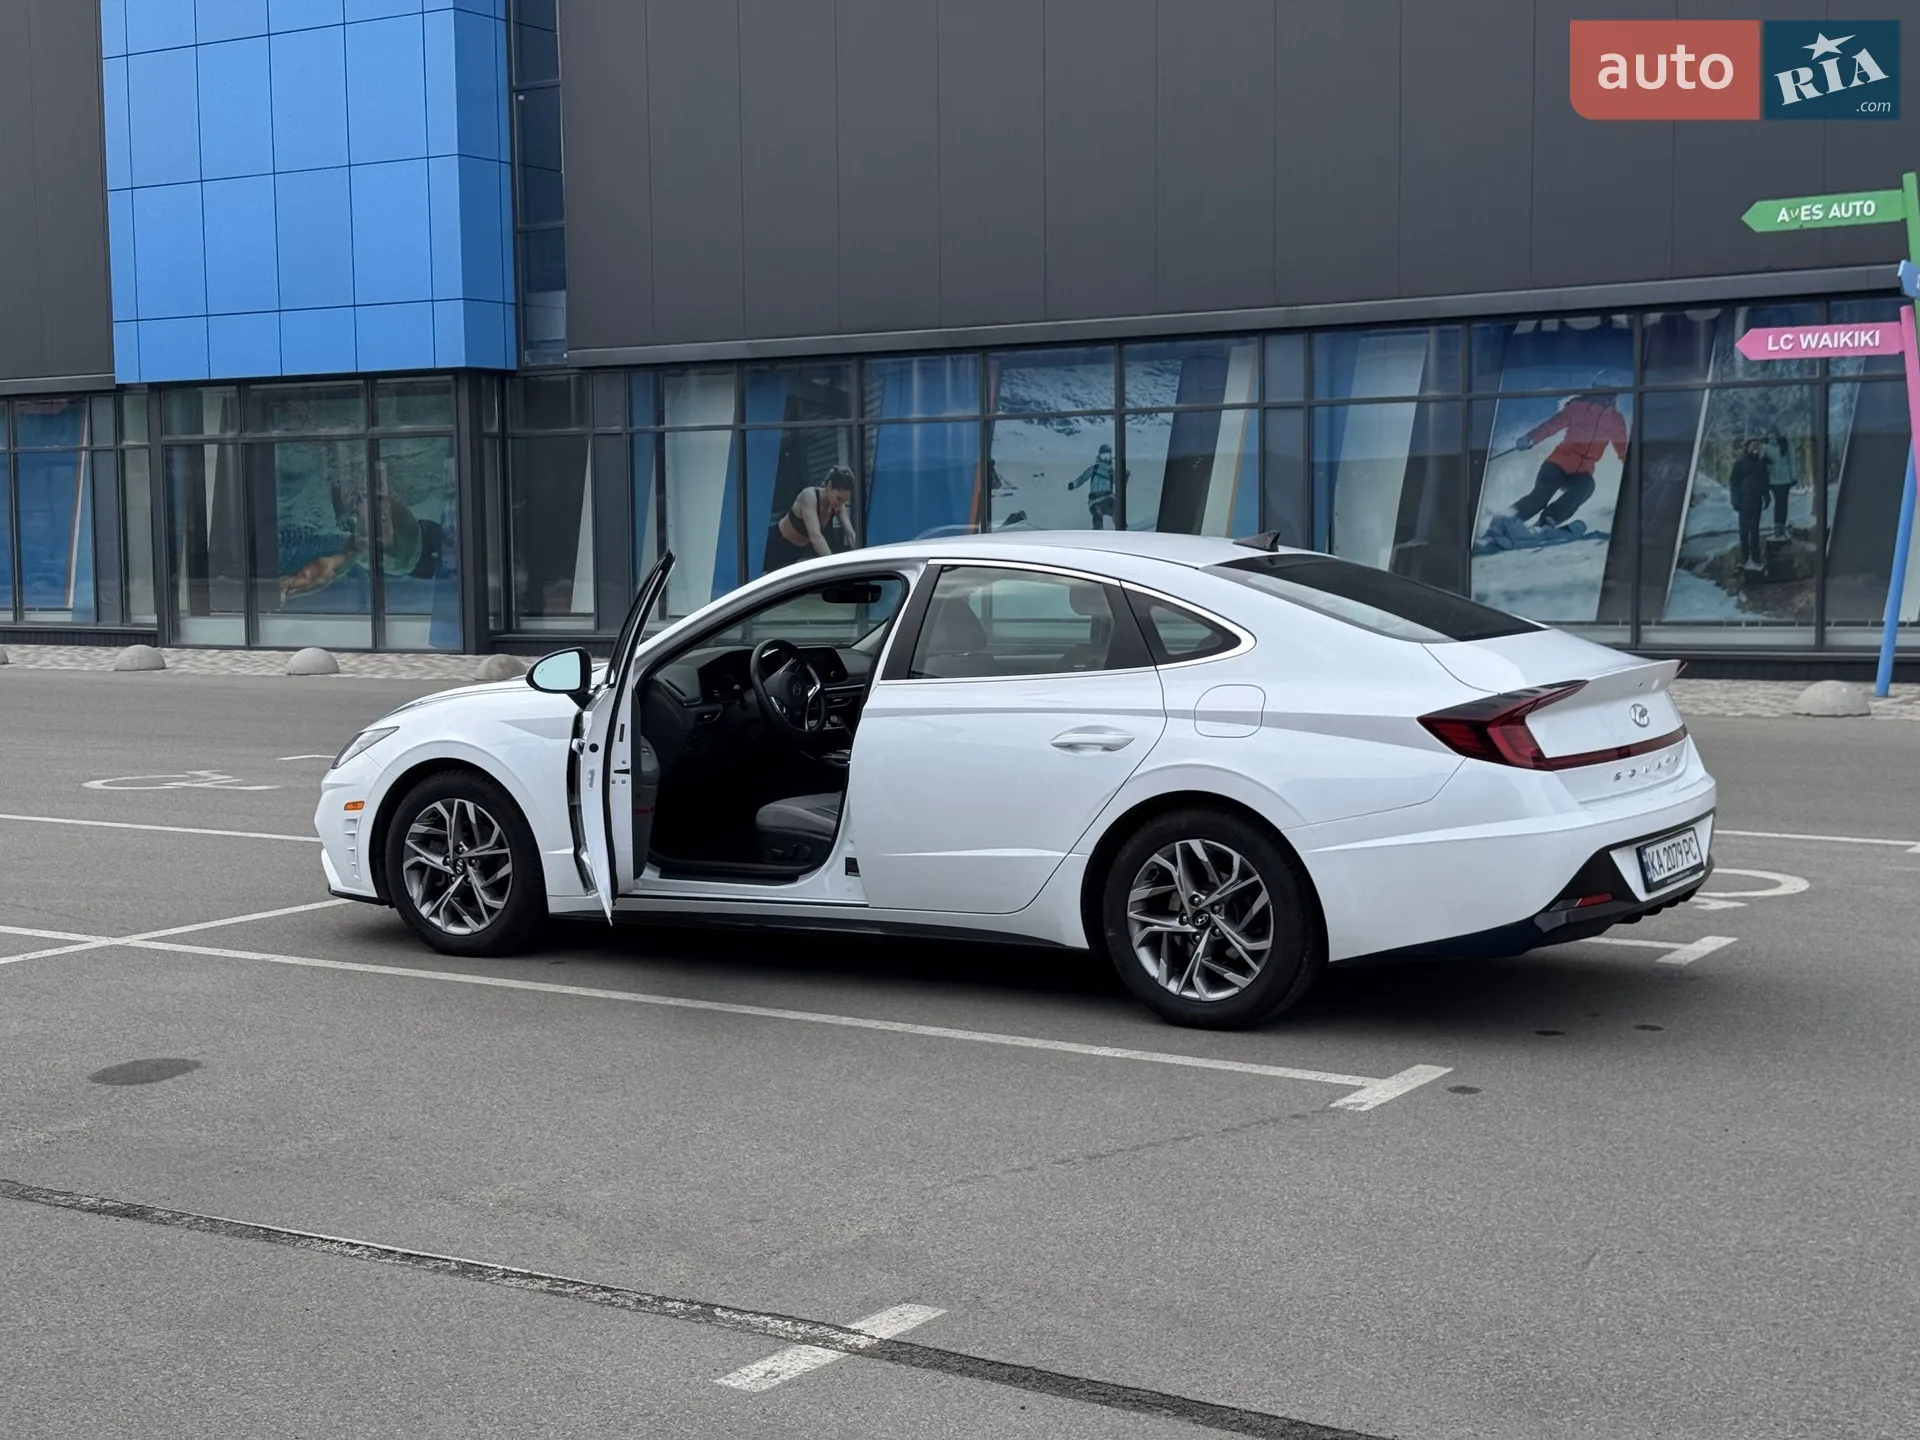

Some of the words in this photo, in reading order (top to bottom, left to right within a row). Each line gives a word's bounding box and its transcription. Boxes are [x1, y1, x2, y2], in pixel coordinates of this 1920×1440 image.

[1828, 200, 1876, 218] AUTO
[1767, 333, 1794, 351] LC
[1799, 329, 1881, 350] WAIKIKI
[1648, 849, 1665, 878] KA
[1663, 841, 1684, 872] 2079
[1682, 836, 1698, 864] PC
